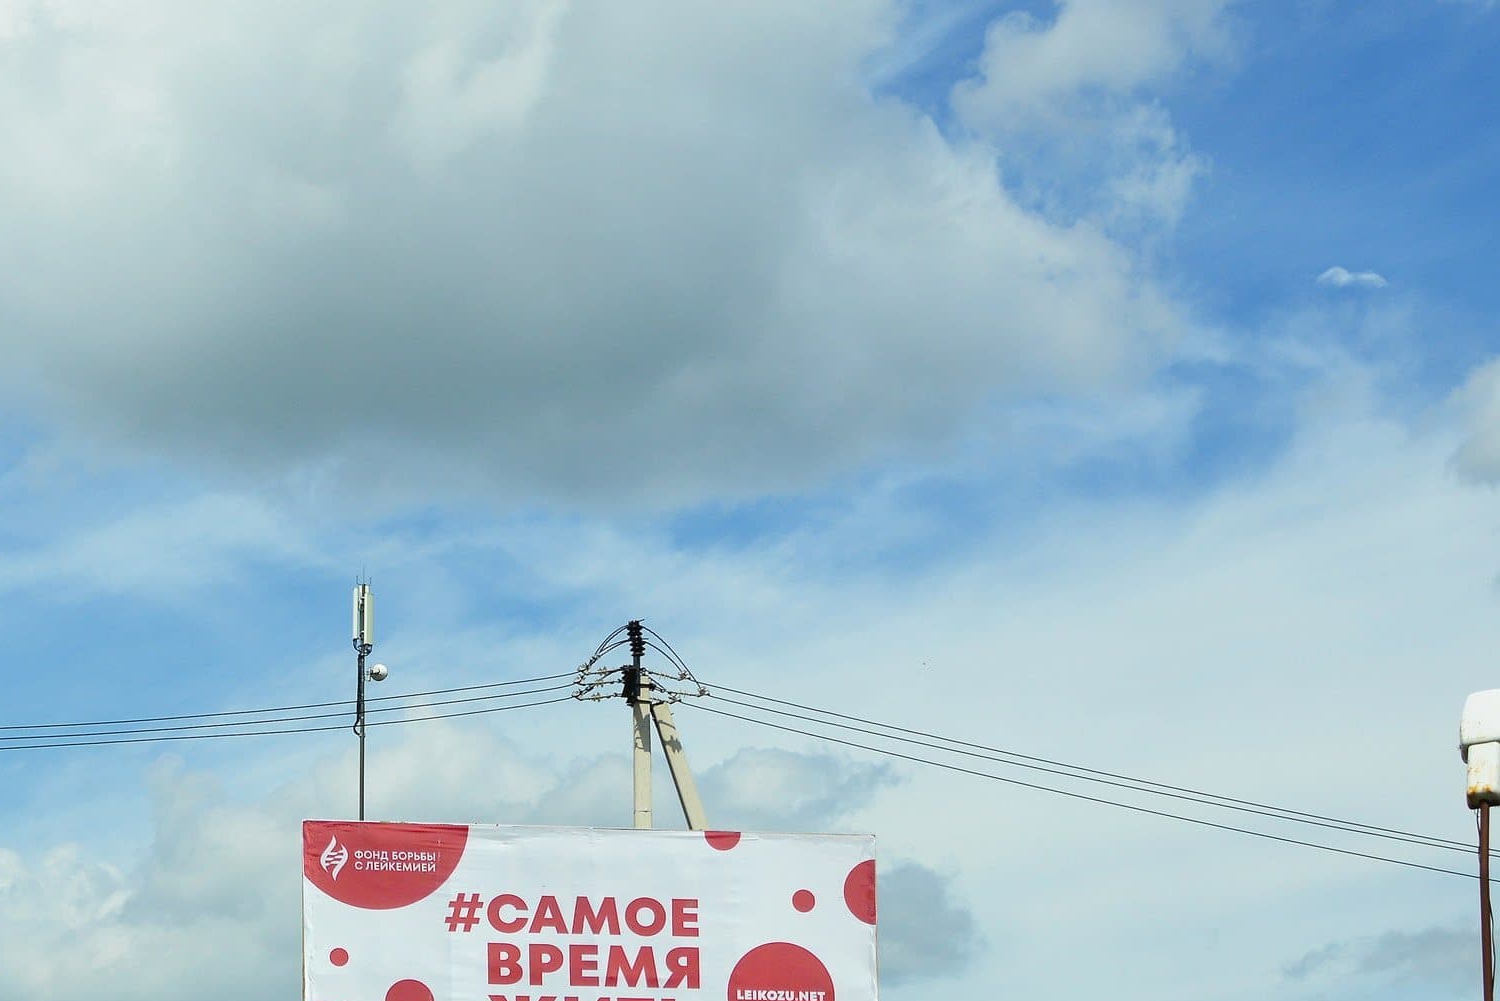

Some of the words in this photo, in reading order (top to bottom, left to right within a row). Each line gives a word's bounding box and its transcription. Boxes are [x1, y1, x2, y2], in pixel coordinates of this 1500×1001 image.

[354, 850, 388, 861] ФОНД
[392, 851, 436, 861] БОРЬБЫ
[355, 861, 363, 870] С
[366, 860, 436, 872] ЛЕЙКЕМИЕЙ
[445, 893, 699, 937] #САМОЕ
[487, 943, 700, 989] ВРЕМЯ
[736, 989, 826, 1001] LEIKOZU.NET
